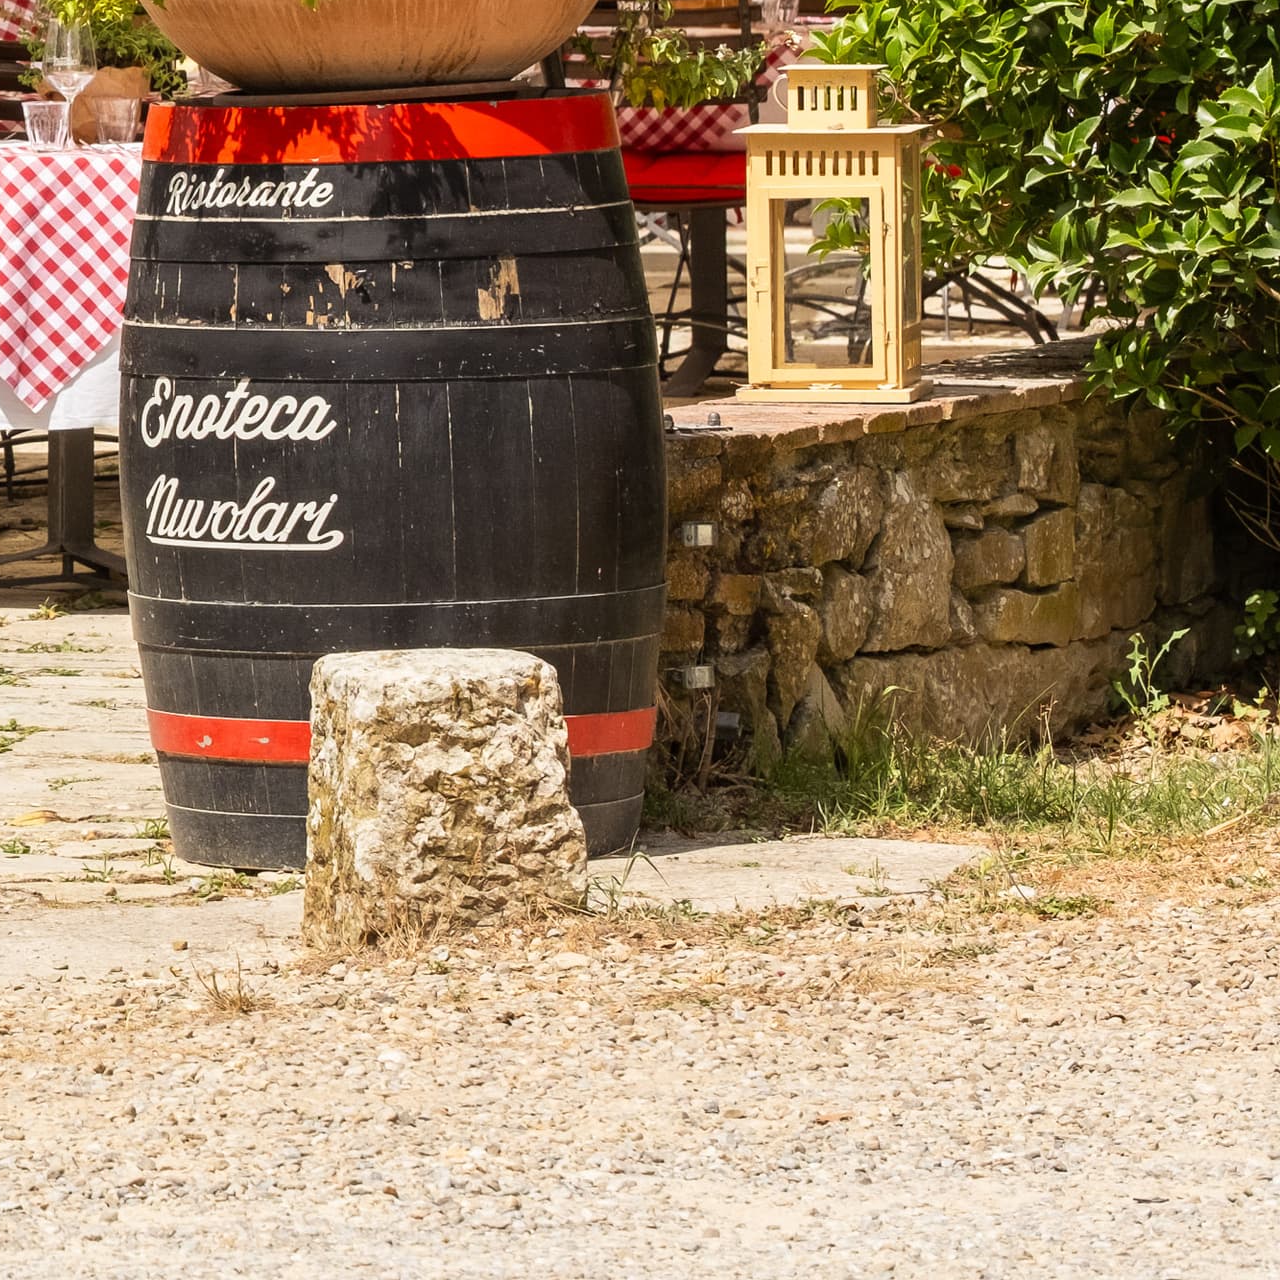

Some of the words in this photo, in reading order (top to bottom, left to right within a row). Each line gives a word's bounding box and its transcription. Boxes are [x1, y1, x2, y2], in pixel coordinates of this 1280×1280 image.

[165, 167, 334, 215] Ristorante
[140, 376, 337, 449] Enoteca
[145, 475, 344, 552] Nuvolari
